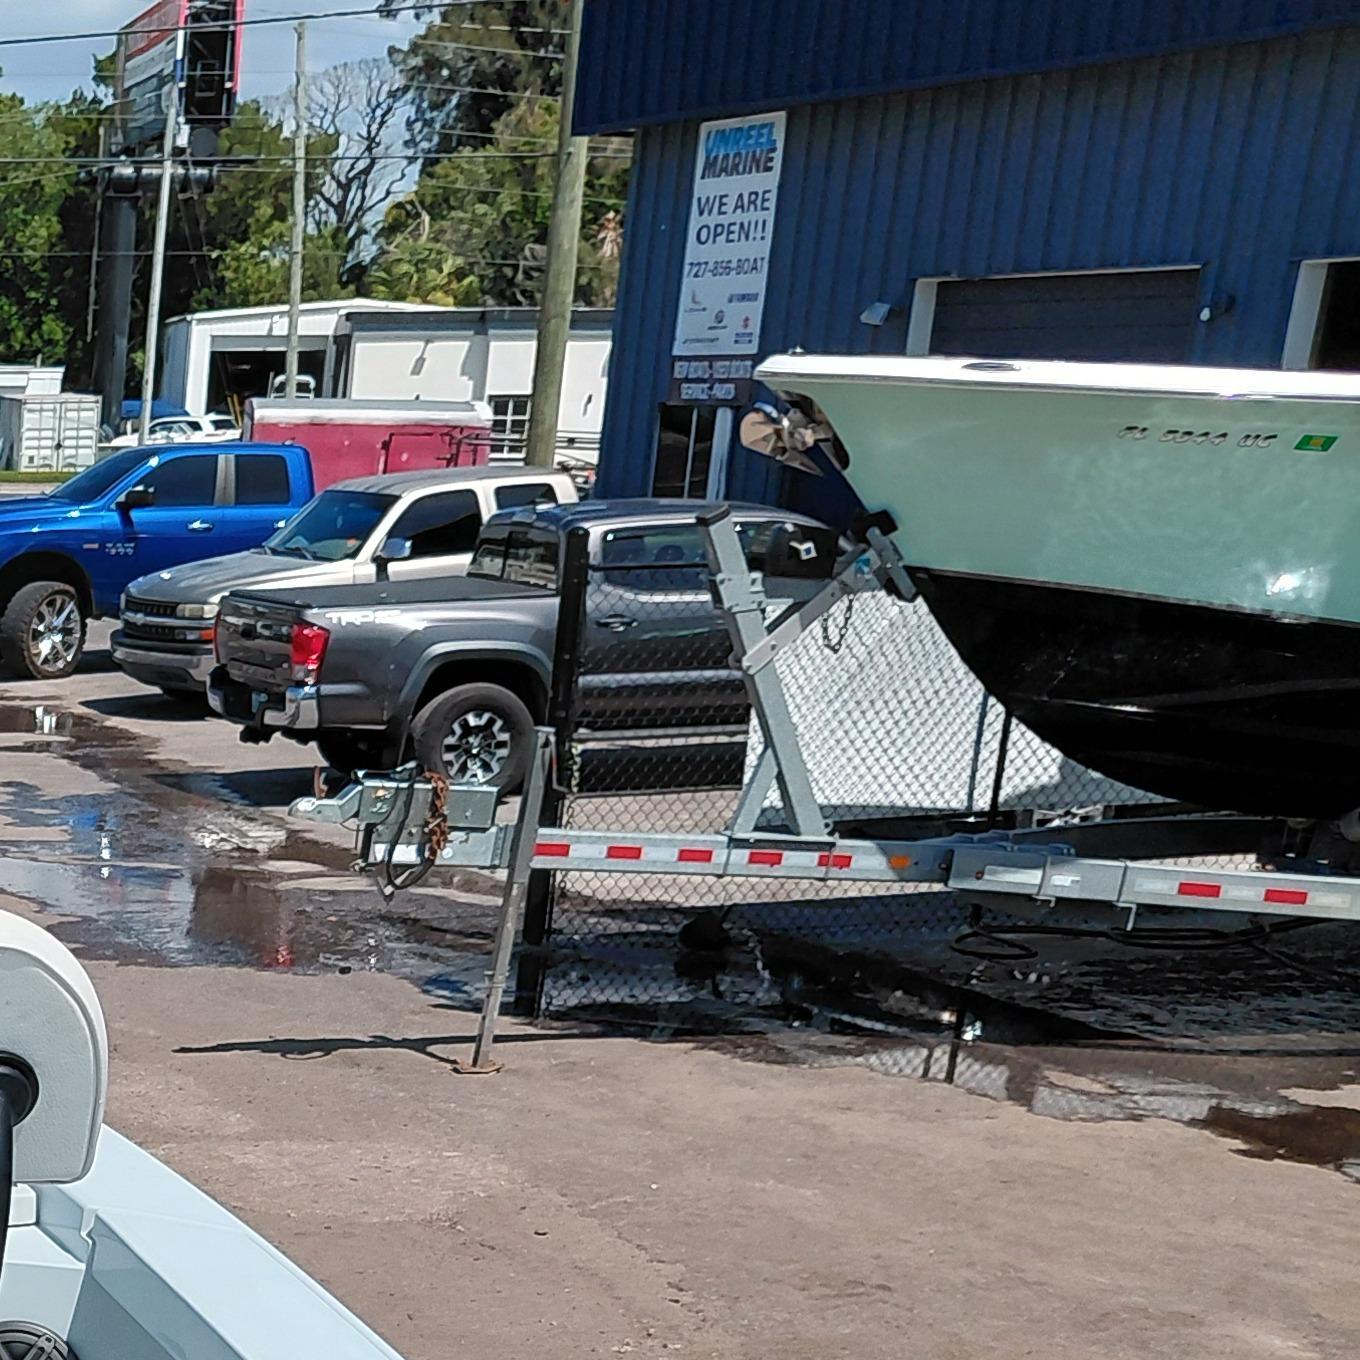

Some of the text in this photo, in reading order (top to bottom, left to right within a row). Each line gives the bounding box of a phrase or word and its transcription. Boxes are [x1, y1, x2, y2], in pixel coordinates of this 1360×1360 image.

[700, 147, 778, 180] MARINE
[697, 189, 772, 217] WE ARE
[695, 219, 767, 246] OPEN!!
